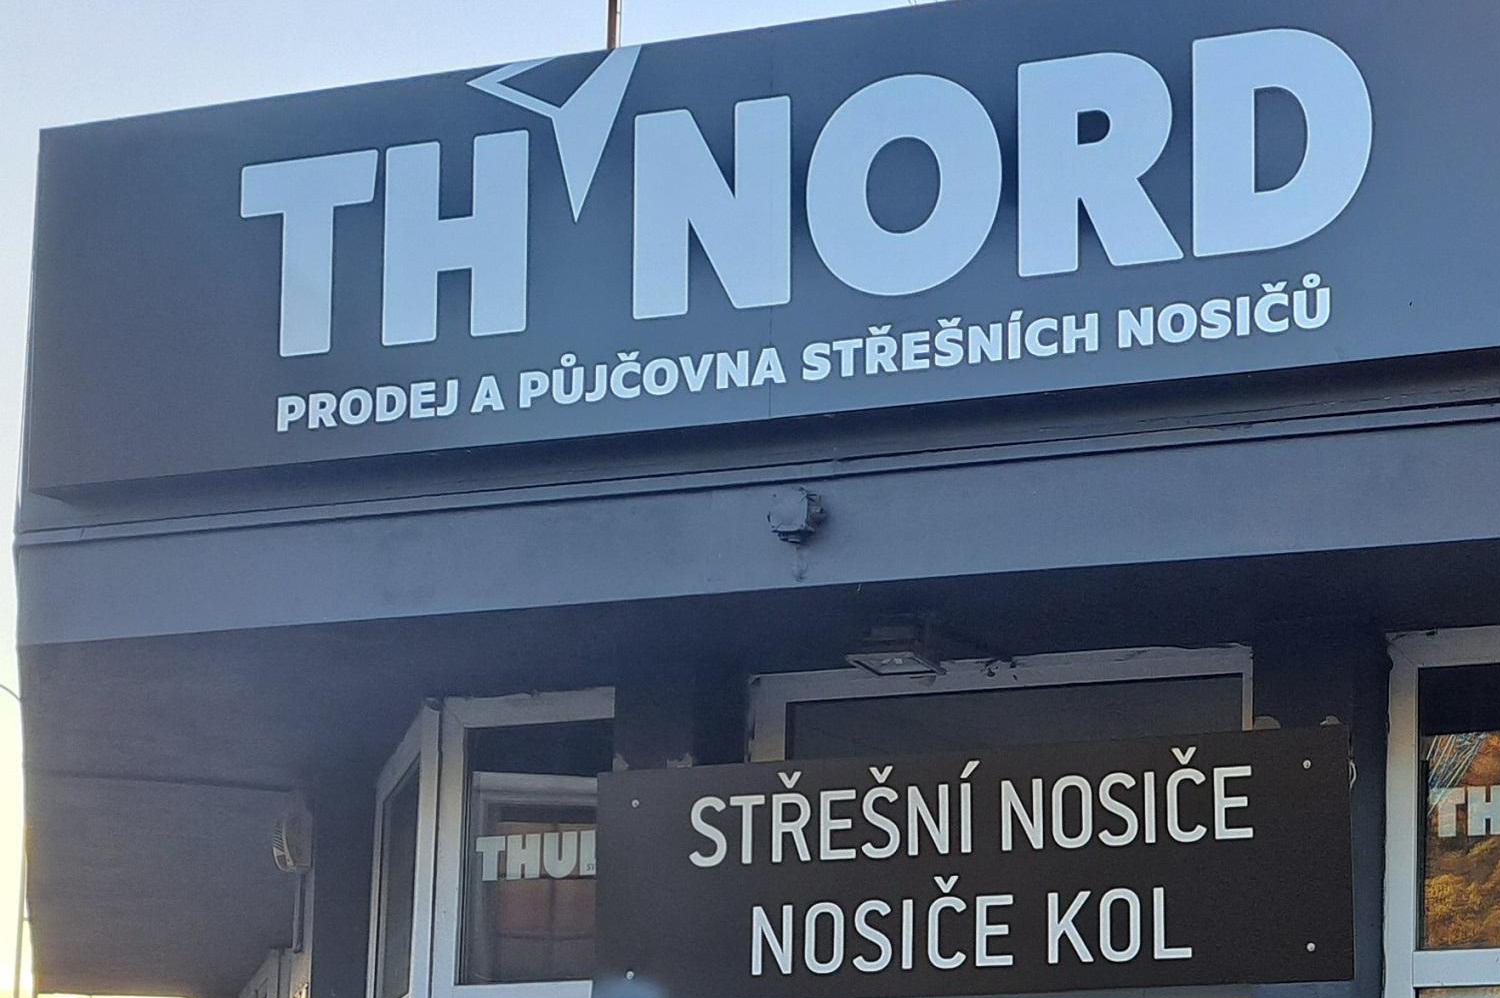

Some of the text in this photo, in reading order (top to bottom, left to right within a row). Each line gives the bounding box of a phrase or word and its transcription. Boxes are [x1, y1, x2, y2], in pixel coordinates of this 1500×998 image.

[633, 27, 1373, 321] NORD
[276, 272, 1331, 433] PRODEJ A PŮJČOVNA STŘEŠNÍCH NOSIČŮ
[688, 746, 1254, 868] STŘEŠNÍ NOSIČE
[752, 875, 1193, 977] NOSIČE KOL
